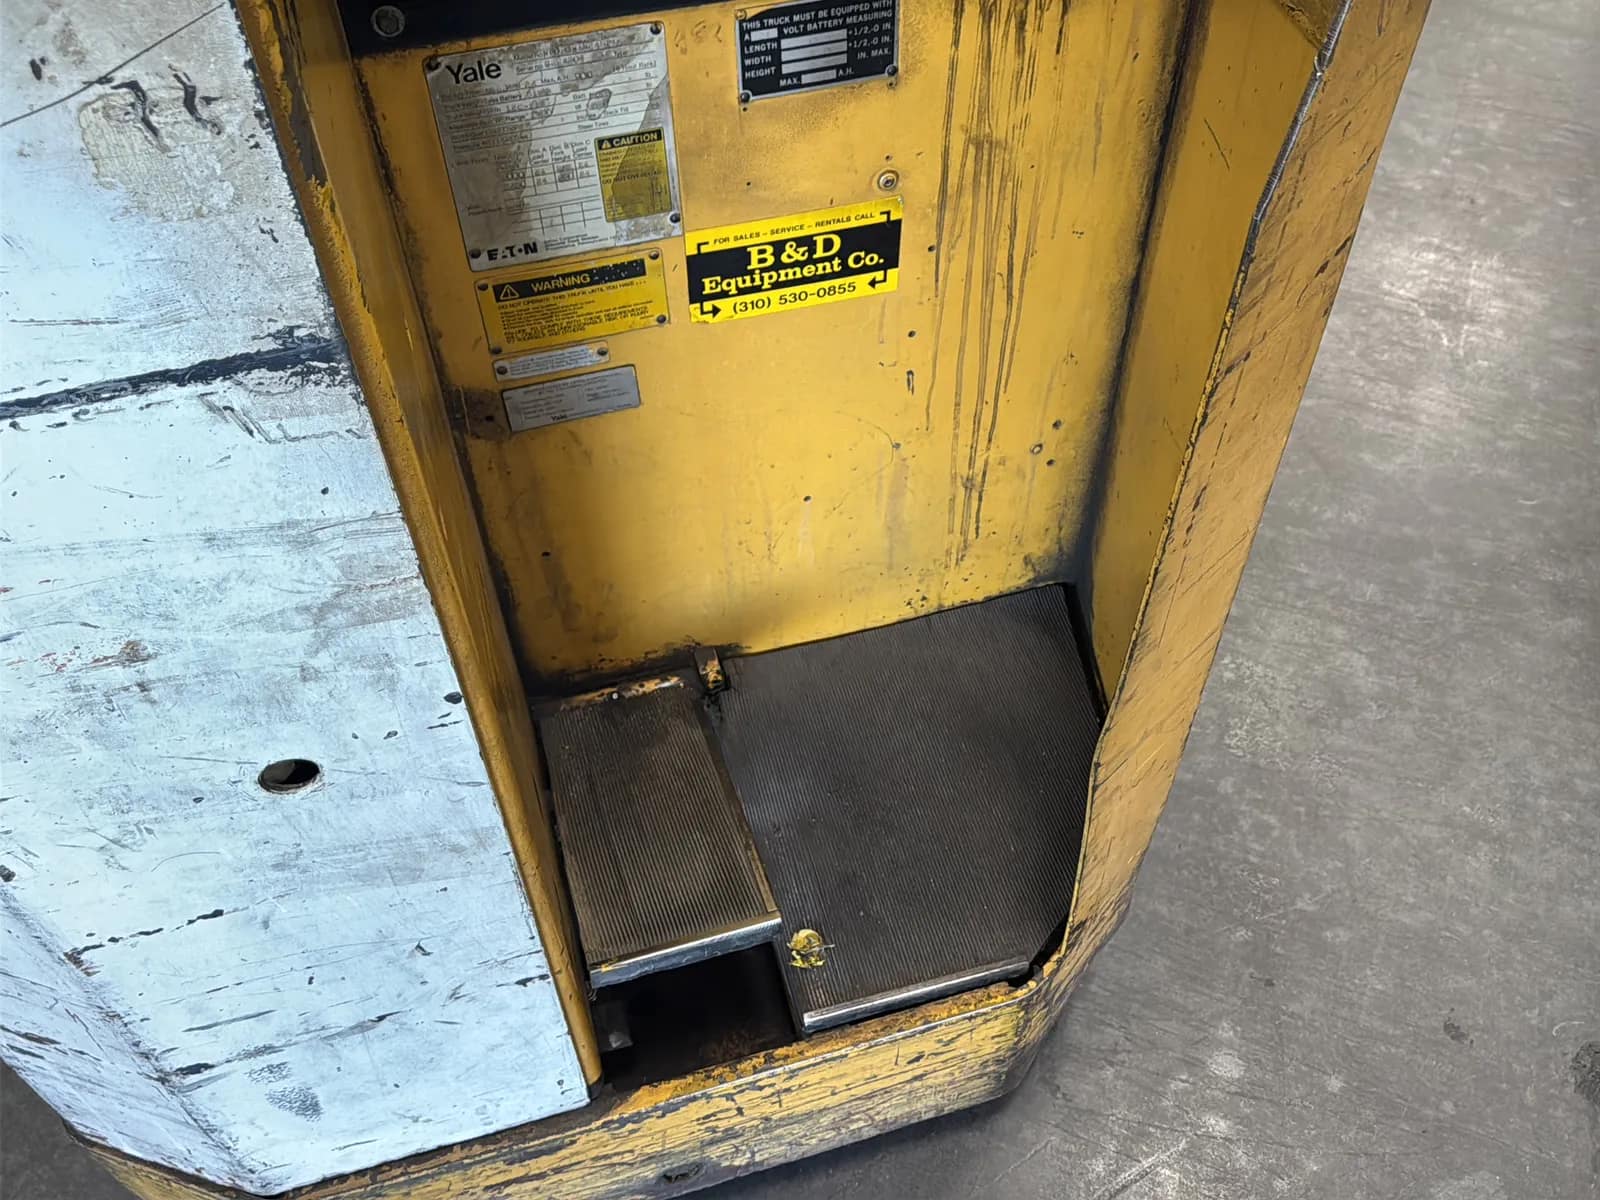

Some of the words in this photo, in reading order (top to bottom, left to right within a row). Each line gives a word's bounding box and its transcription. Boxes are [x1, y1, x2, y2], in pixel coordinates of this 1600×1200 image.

[743, 21, 760, 31] THIS
[763, 16, 790, 27] TRUCK
[793, 12, 815, 22] MUST
[818, 9, 828, 18] BE
[831, 2, 870, 18] EQUIPPED
[872, 0, 893, 9] WITH
[783, 25, 804, 35] VOLT
[807, 19, 843, 31] BATTERY
[846, 10, 893, 23] MEASURING
[744, 42, 777, 54] LENGTH
[871, 48, 891, 57] MAX.
[744, 56, 771, 66] WIDTH
[446, 60, 502, 85] Yale
[744, 67, 776, 79] HEIGHT
[779, 78, 801, 87] MAX.
[612, 132, 658, 147] CAUTION
[713, 236, 729, 245] FOR
[733, 231, 760, 241] SALES
[770, 223, 805, 236] SERVICE
[815, 216, 852, 229] RENTALS
[855, 212, 874, 221] CALL
[746, 245, 775, 270] B
[781, 240, 809, 263] &
[812, 233, 842, 258] D
[531, 273, 591, 293] WARNING
[701, 256, 842, 296] Equipment
[847, 250, 885, 269] Co.
[732, 296, 772, 315] (310)
[778, 281, 856, 305] 530-0855
